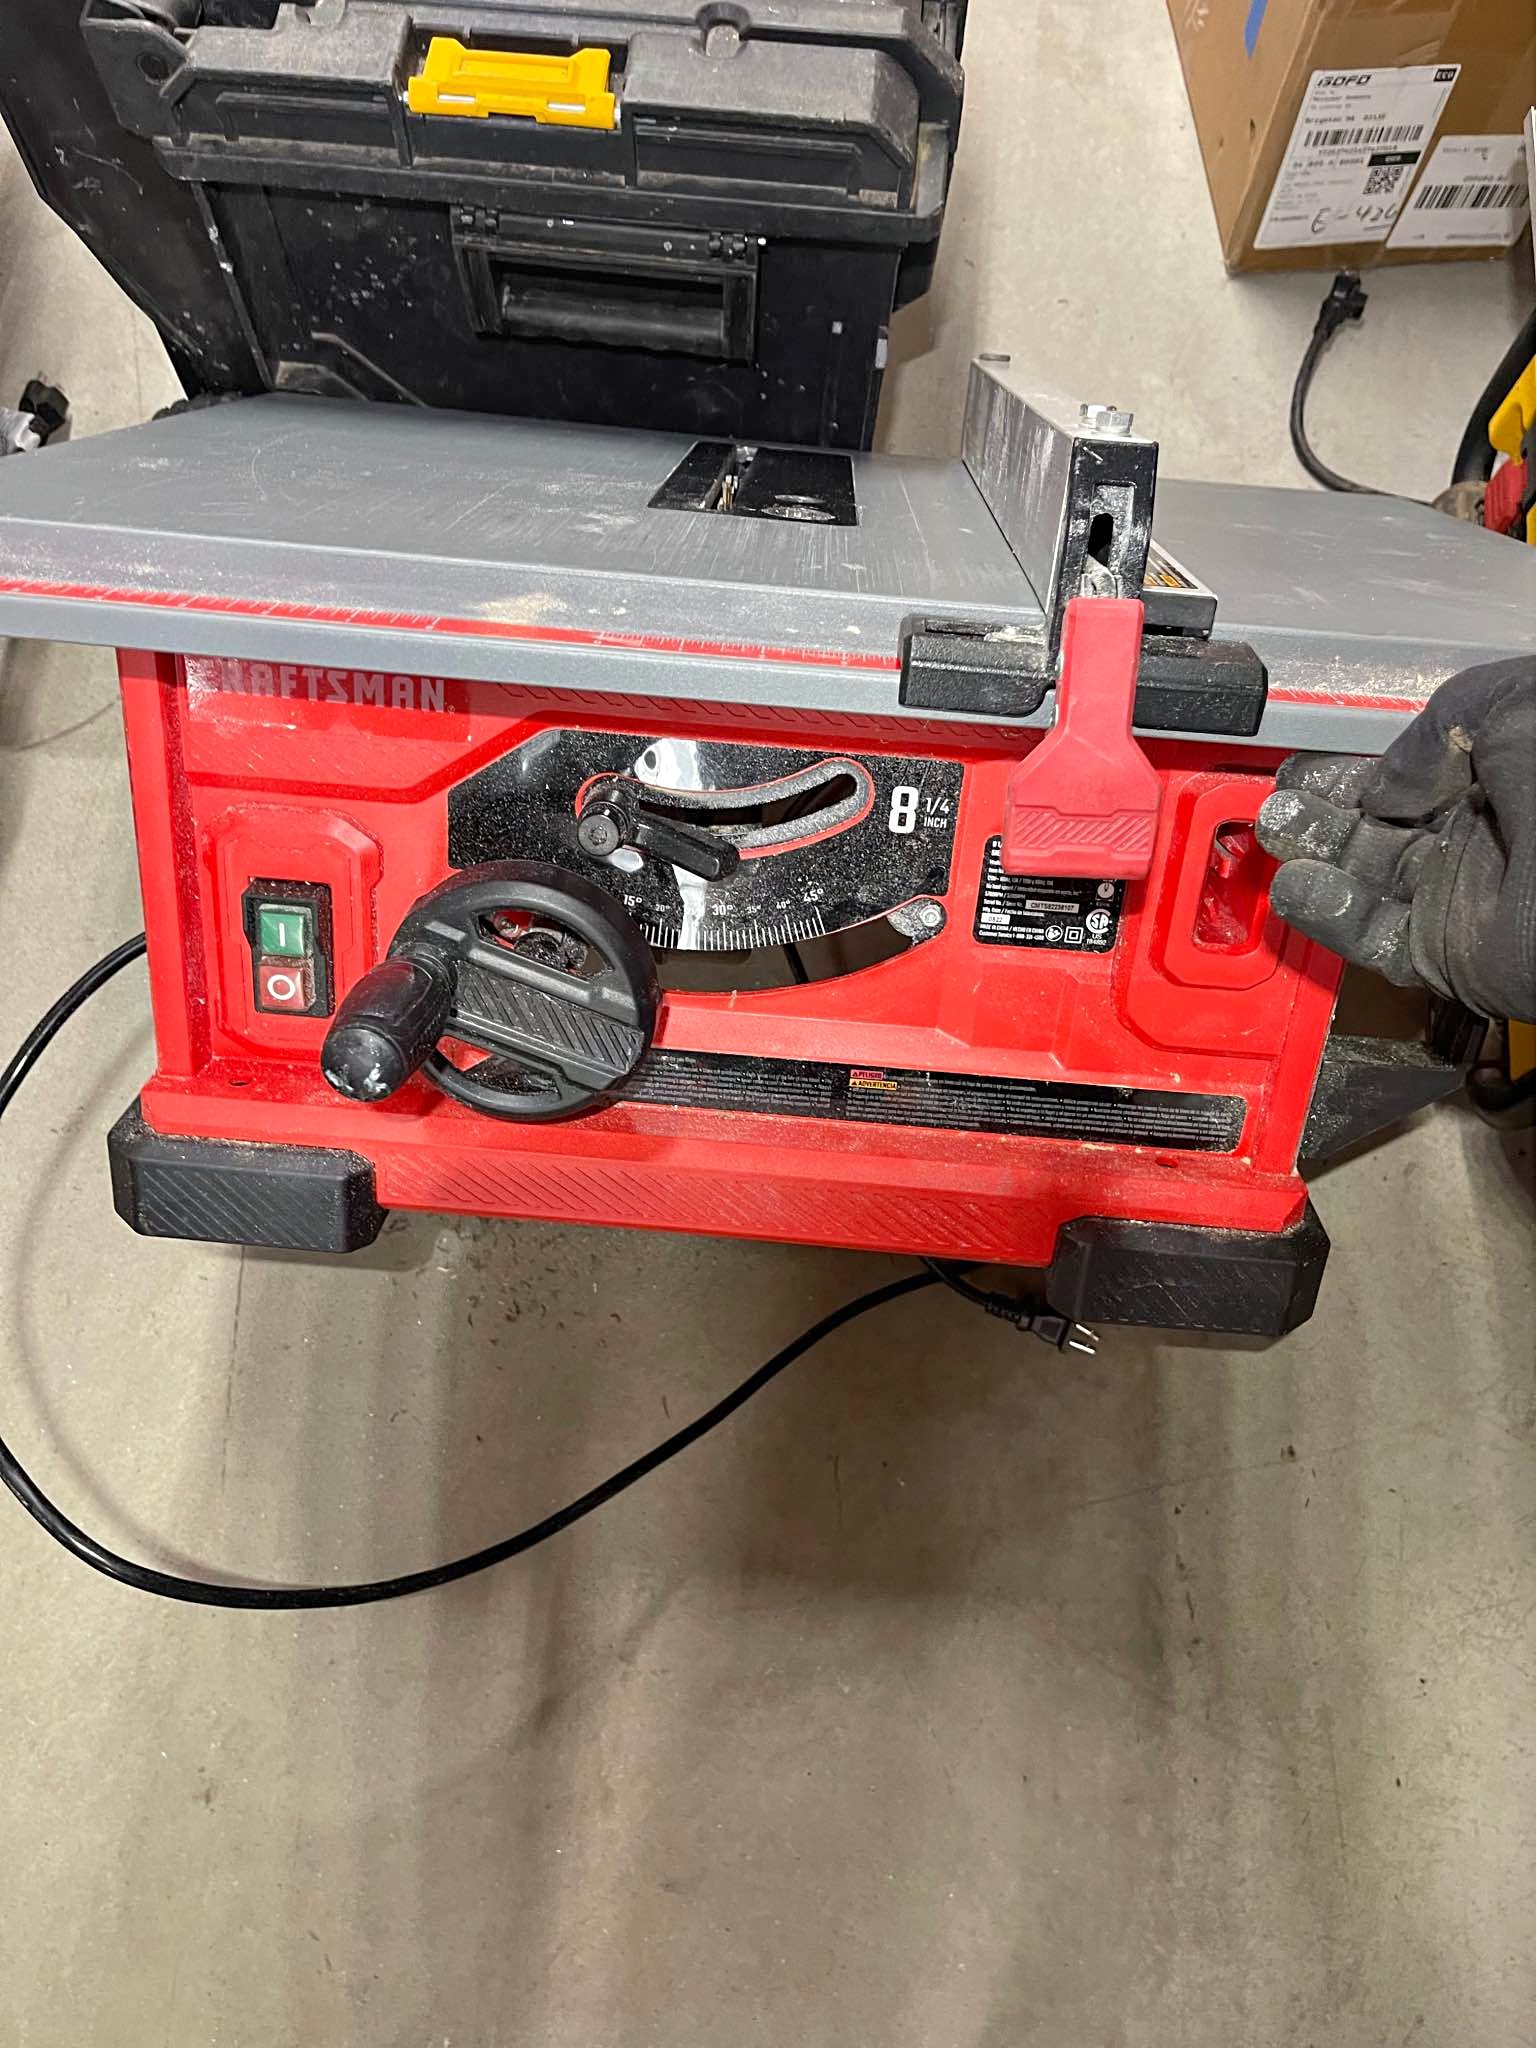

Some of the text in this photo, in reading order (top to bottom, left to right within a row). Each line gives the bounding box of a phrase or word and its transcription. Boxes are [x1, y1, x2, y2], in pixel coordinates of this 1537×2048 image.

[889, 785, 919, 834] 8
[925, 796, 950, 815] 1/4
[923, 816, 947, 829] INCH
